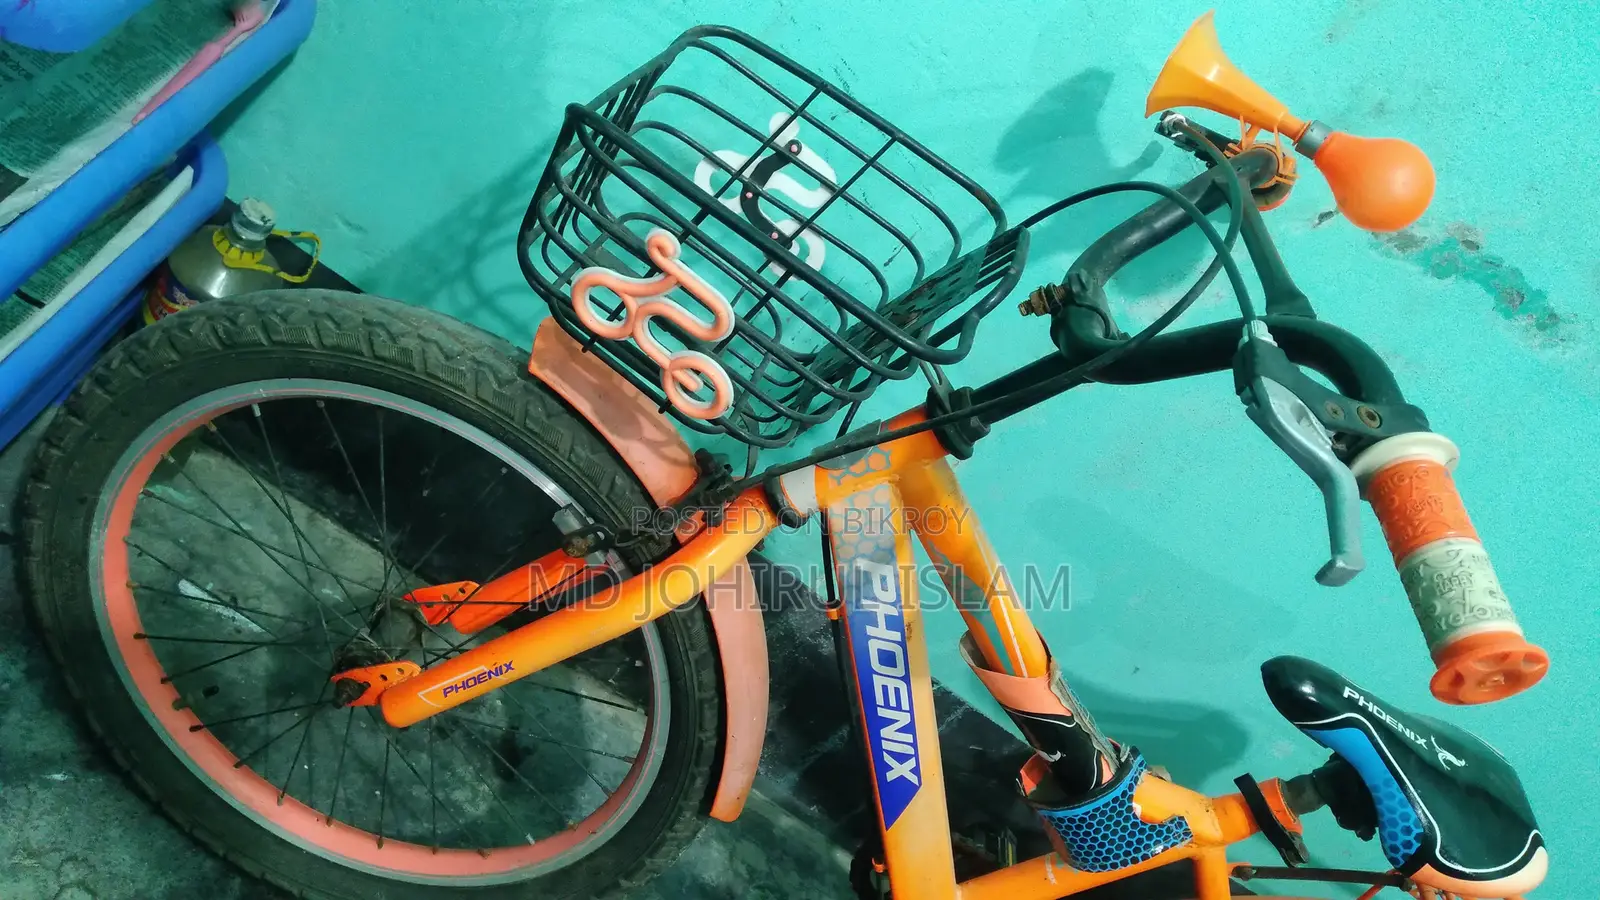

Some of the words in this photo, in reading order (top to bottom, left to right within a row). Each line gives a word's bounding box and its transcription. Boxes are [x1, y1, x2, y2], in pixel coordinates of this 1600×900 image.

[442, 660, 516, 699] PHOENIX
[856, 558, 919, 786] PHOENIX
[1342, 685, 1429, 751] PHOENIX
